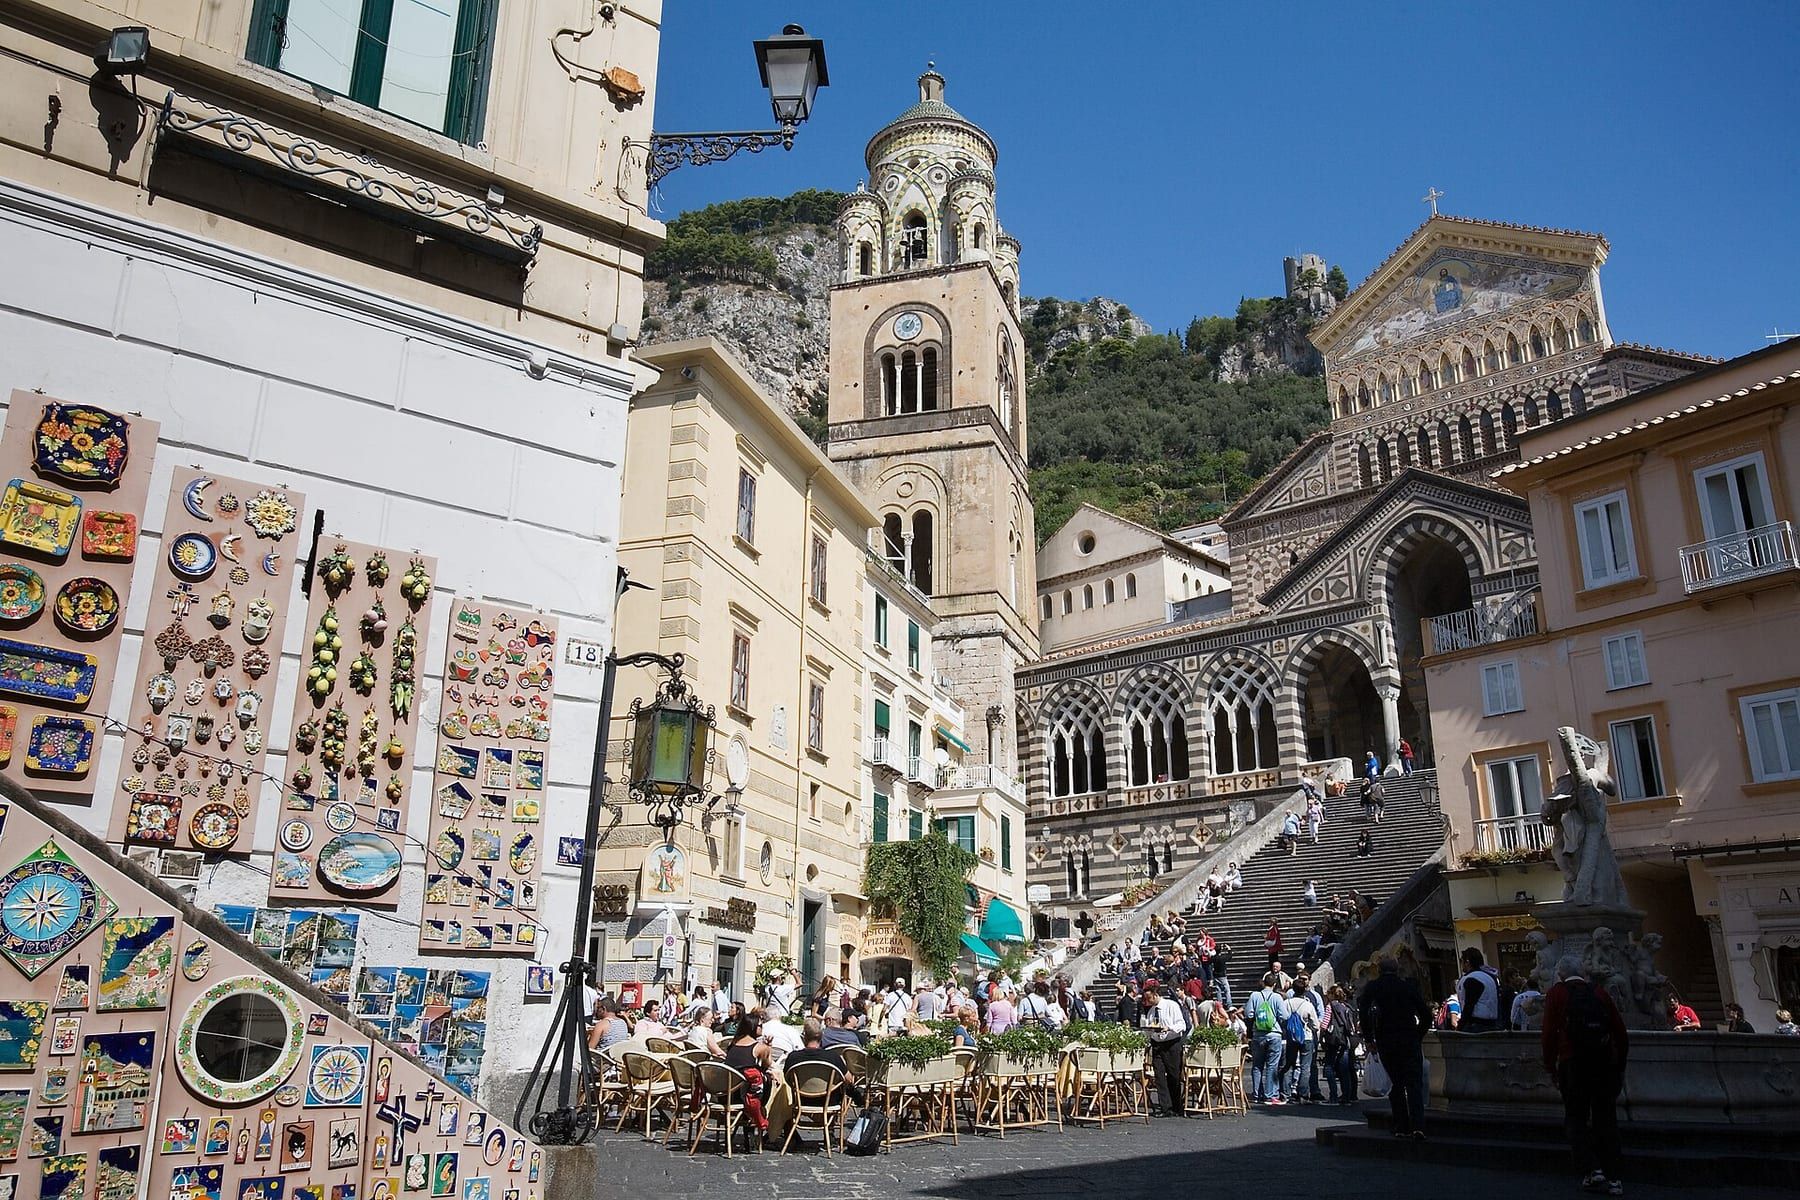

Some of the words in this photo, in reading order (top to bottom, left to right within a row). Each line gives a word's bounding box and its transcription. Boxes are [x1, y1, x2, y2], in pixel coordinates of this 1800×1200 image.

[575, 646, 596, 661] 18
[862, 927, 906, 938] RISTORAN
[867, 937, 904, 946] PIZZERIA
[873, 946, 907, 955] ANDREA
